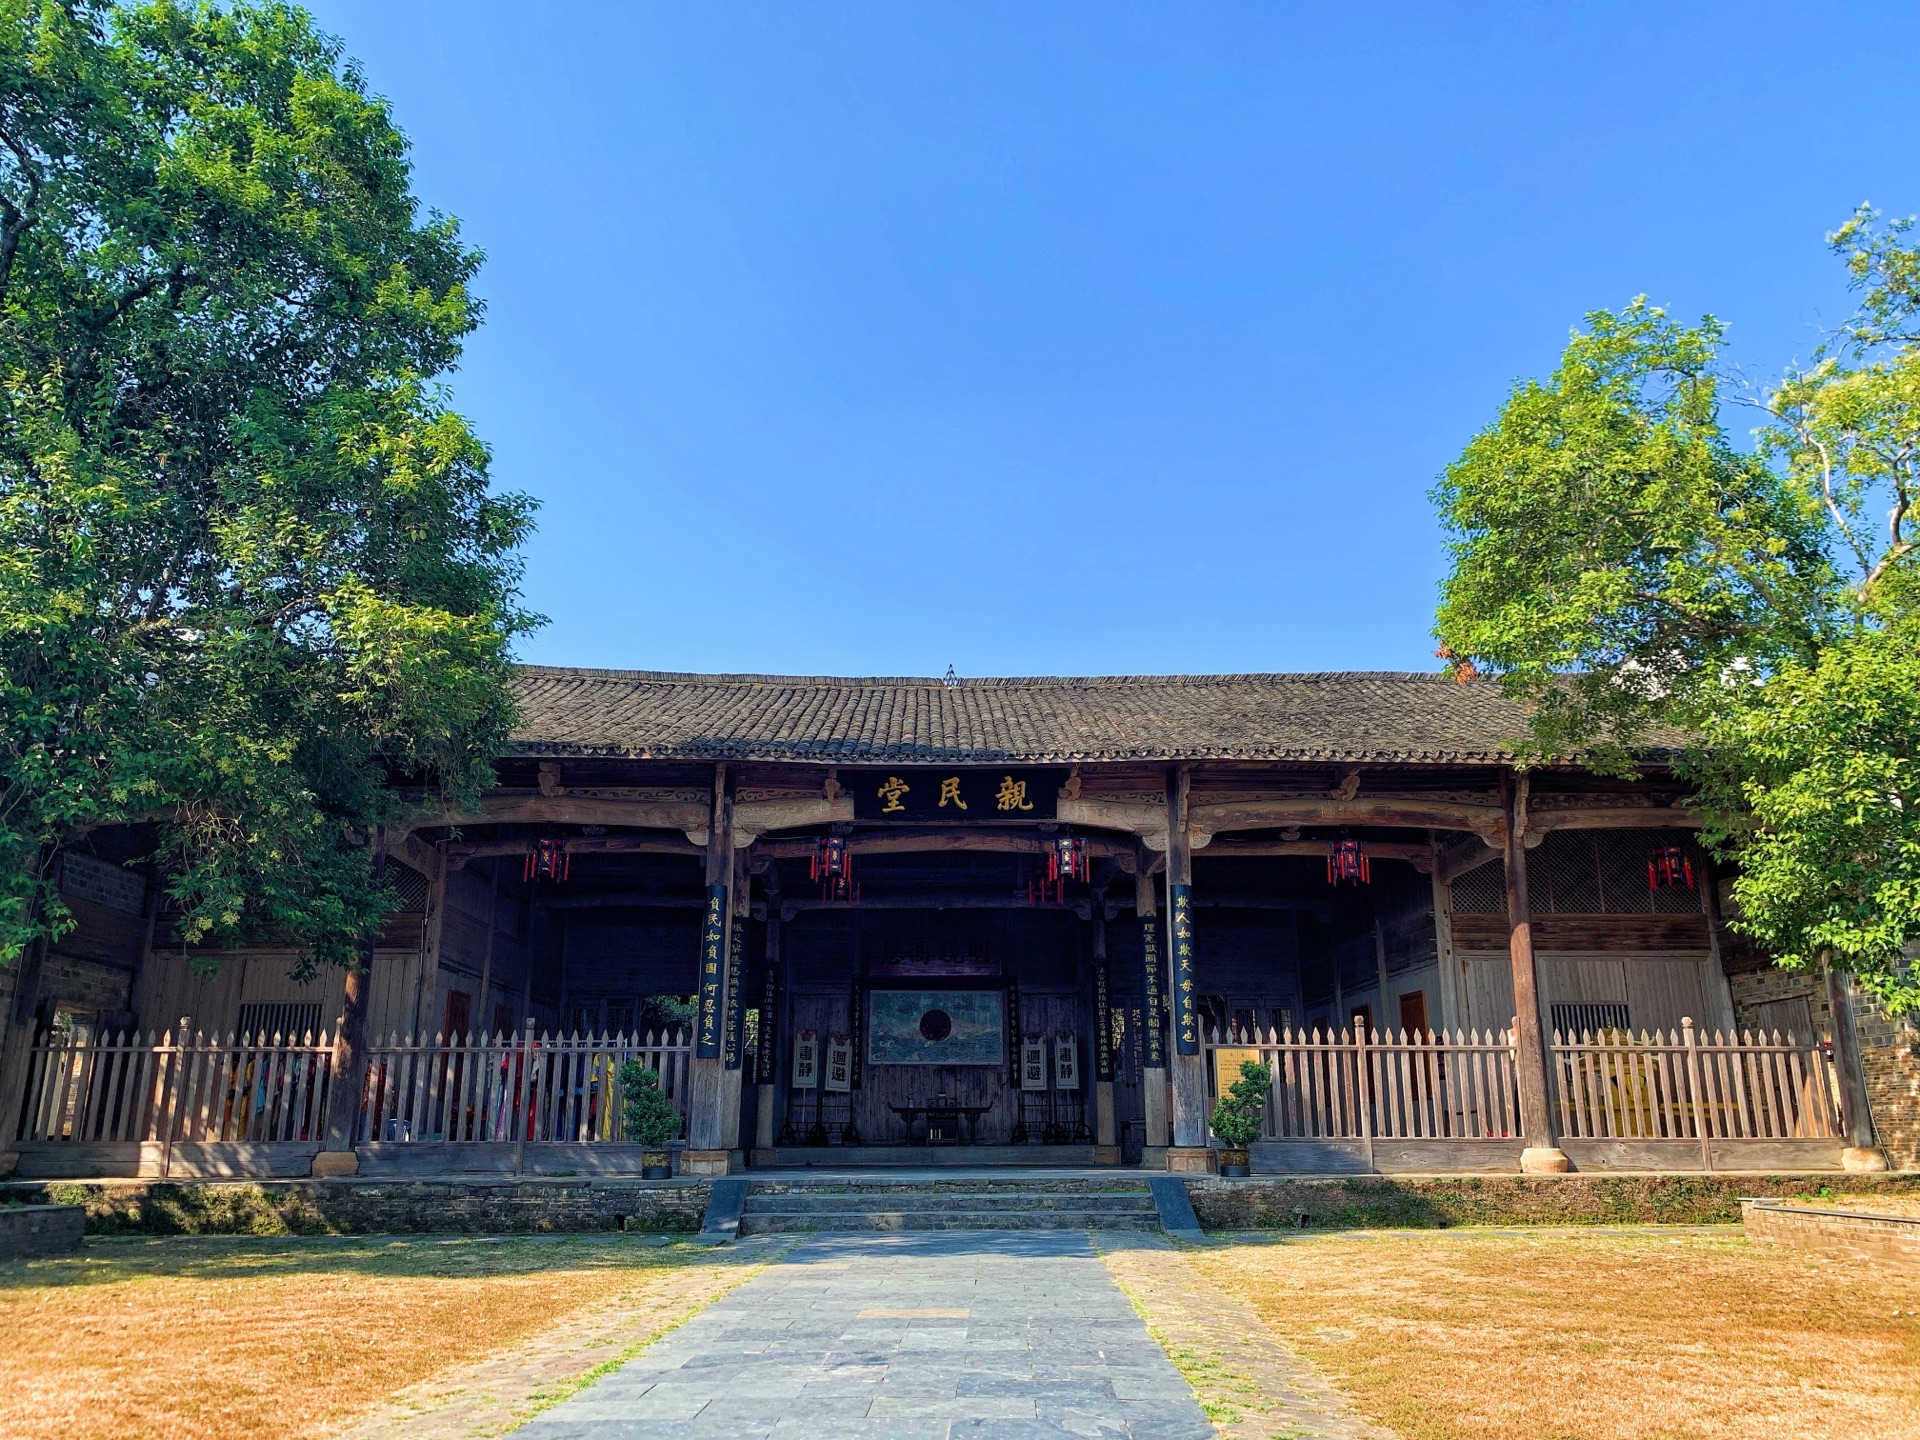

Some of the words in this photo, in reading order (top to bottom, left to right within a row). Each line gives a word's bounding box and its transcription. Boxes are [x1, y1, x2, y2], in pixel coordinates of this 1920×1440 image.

[700, 897, 722, 1046] 負民如負國何忍負之
[1175, 895, 1196, 1043] 欺人如欺天毋自欺也
[798, 1045, 812, 1077] 肅靜
[831, 1050, 847, 1082] 迴避
[1026, 1050, 1041, 1080] 迴避
[1059, 1047, 1072, 1079] 肅靜
